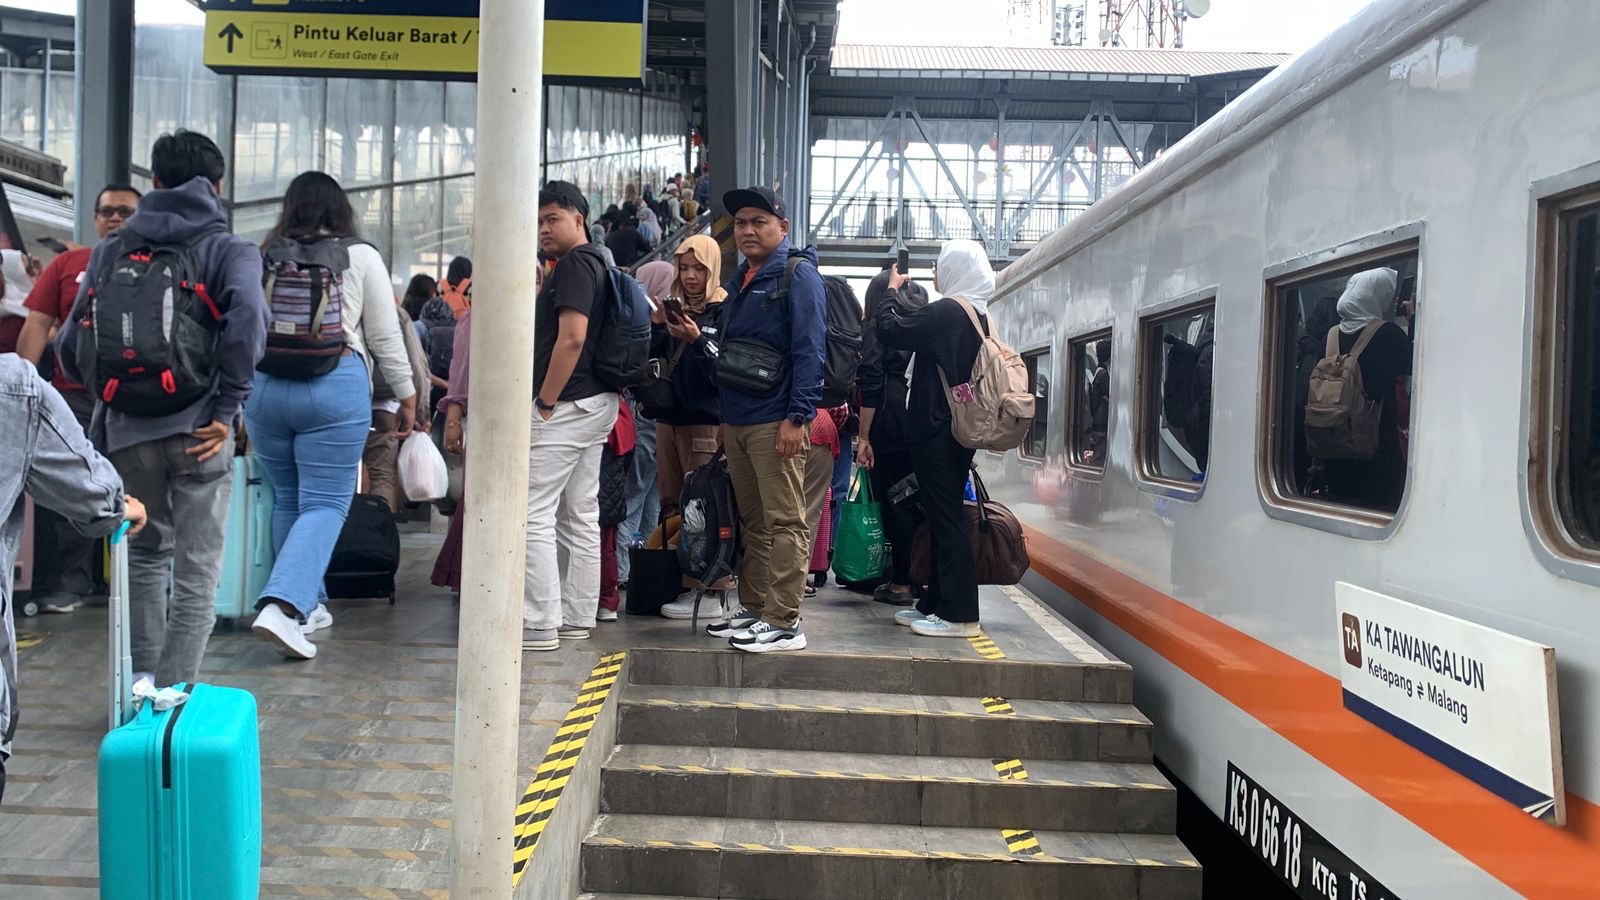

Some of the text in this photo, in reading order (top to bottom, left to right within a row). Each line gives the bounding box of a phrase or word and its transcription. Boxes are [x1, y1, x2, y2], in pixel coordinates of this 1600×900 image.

[292, 49, 318, 58] West
[328, 50, 351, 60] East
[352, 50, 377, 60] Gate
[380, 51, 399, 61] Exit
[293, 24, 340, 40] Pintu
[346, 26, 405, 42] Keluar
[410, 28, 458, 44] Barat
[1344, 626, 1360, 652] TA
[1366, 620, 1485, 692] KA TAWANGALUN
[1368, 657, 1468, 724] Ketapang Malang
[1229, 771, 1248, 837] K3
[1312, 857, 1338, 900] KTG
[1350, 872, 1367, 900] TS
